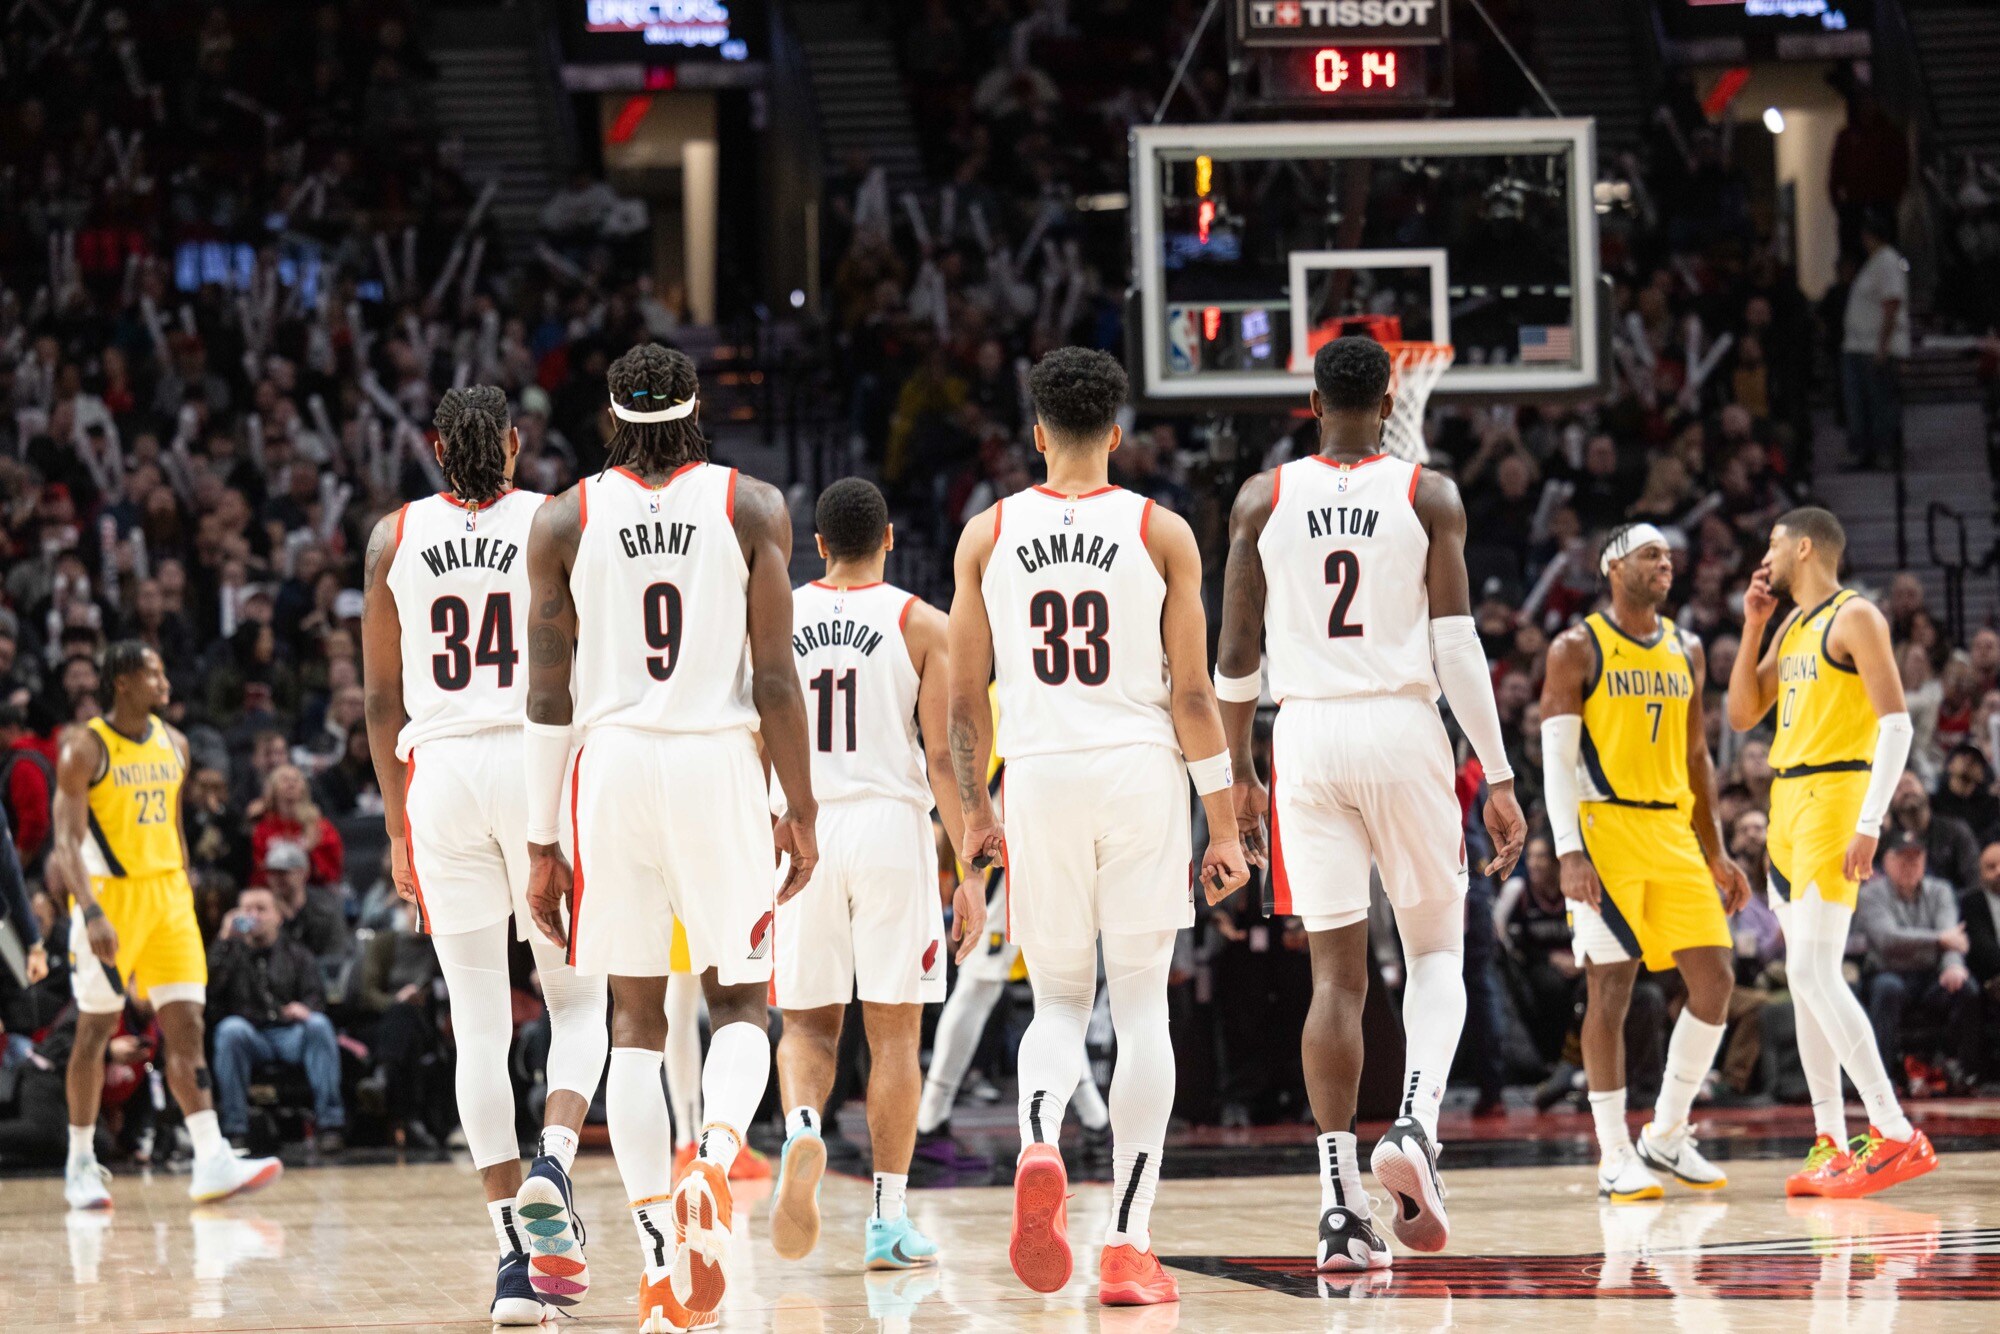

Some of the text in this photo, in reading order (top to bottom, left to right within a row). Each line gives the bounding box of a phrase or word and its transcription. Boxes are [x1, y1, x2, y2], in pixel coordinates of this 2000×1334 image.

[1303, 1, 1434, 27] TISSOT
[619, 522, 697, 559] GRANT
[1307, 507, 1379, 538] AYTON
[421, 537, 519, 578] WALKER
[1016, 533, 1120, 574] CAMARA
[1324, 549, 1364, 639] 2
[430, 592, 519, 692] 34
[643, 582, 683, 682] 9
[792, 620, 883, 657] BROGDON
[1029, 589, 1111, 687] 33
[1606, 670, 1689, 698] INDIANA
[810, 668, 857, 753] 11
[1646, 703, 1663, 744] 7
[1783, 688, 1796, 728] 0
[135, 789, 167, 824] 23
